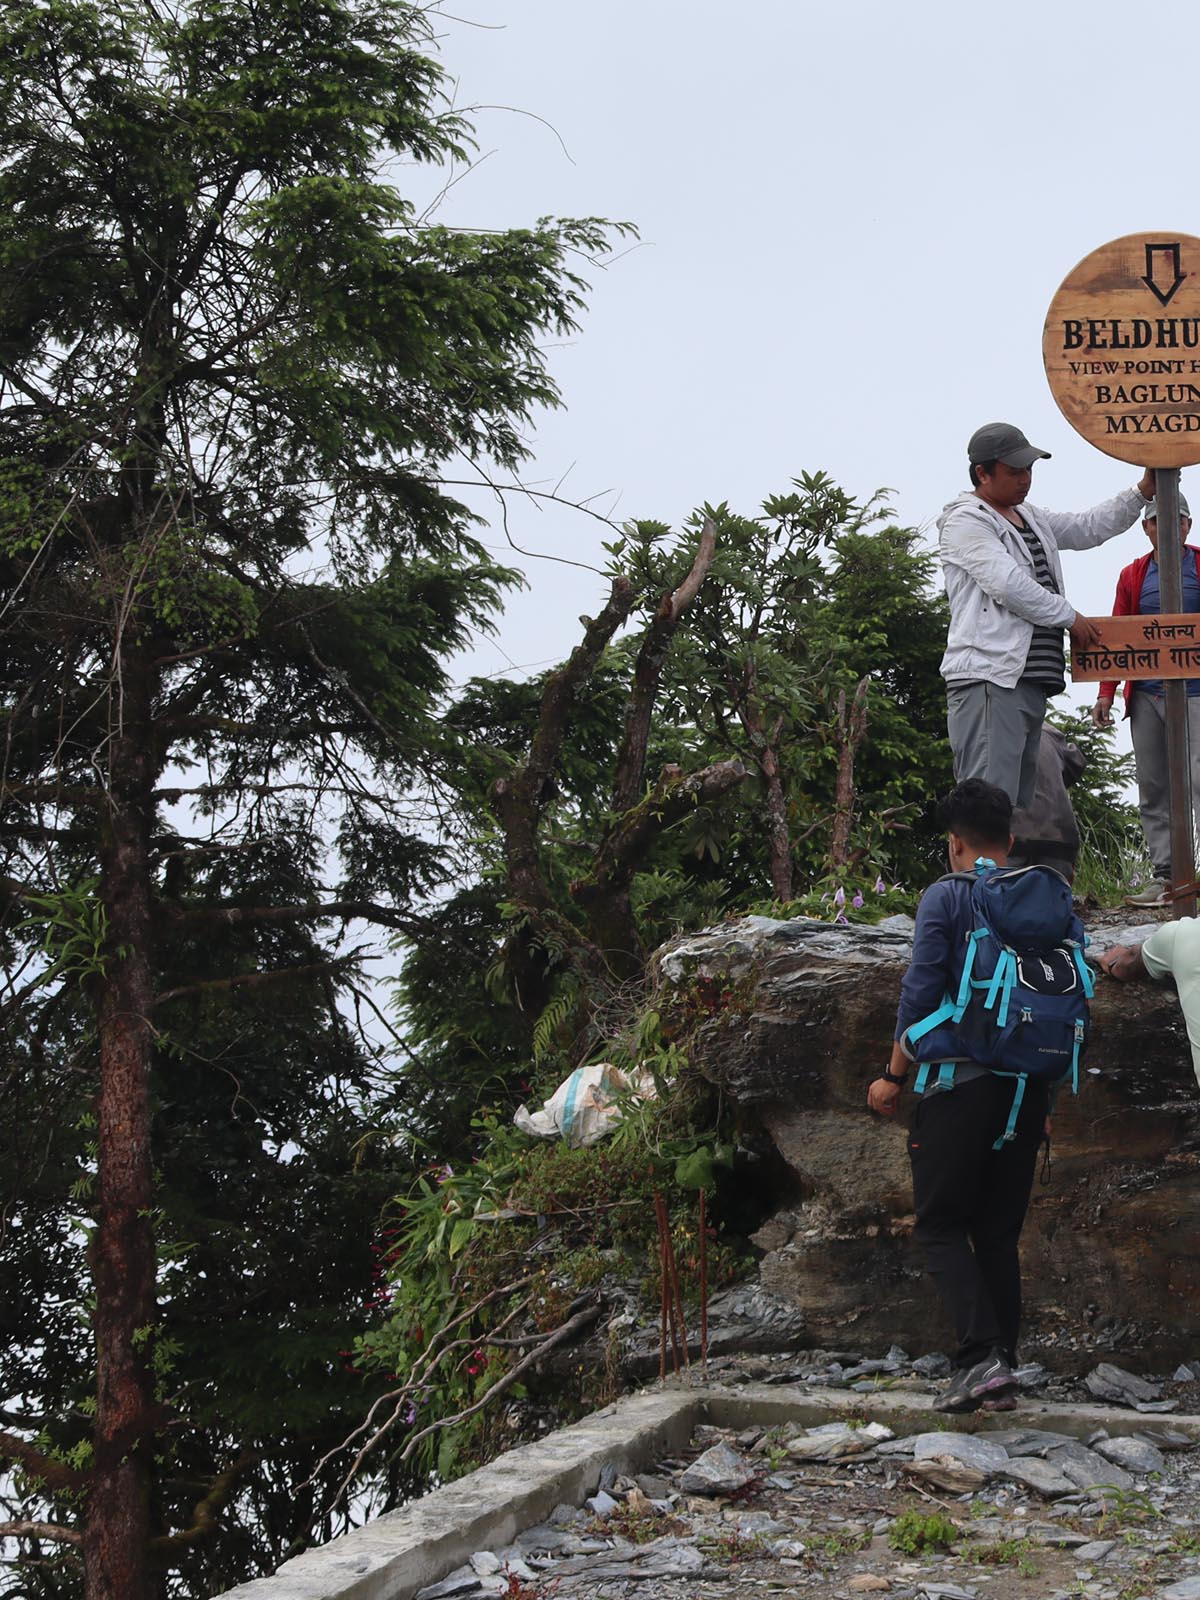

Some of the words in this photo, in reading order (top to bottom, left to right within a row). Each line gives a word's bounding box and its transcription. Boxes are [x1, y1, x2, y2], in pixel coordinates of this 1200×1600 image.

[1069, 361, 1119, 374] VIEW
[1124, 359, 1185, 374] POINT
[1142, 619, 1197, 641] सौजन्य
[1075, 643, 1160, 673] काठेखोला
